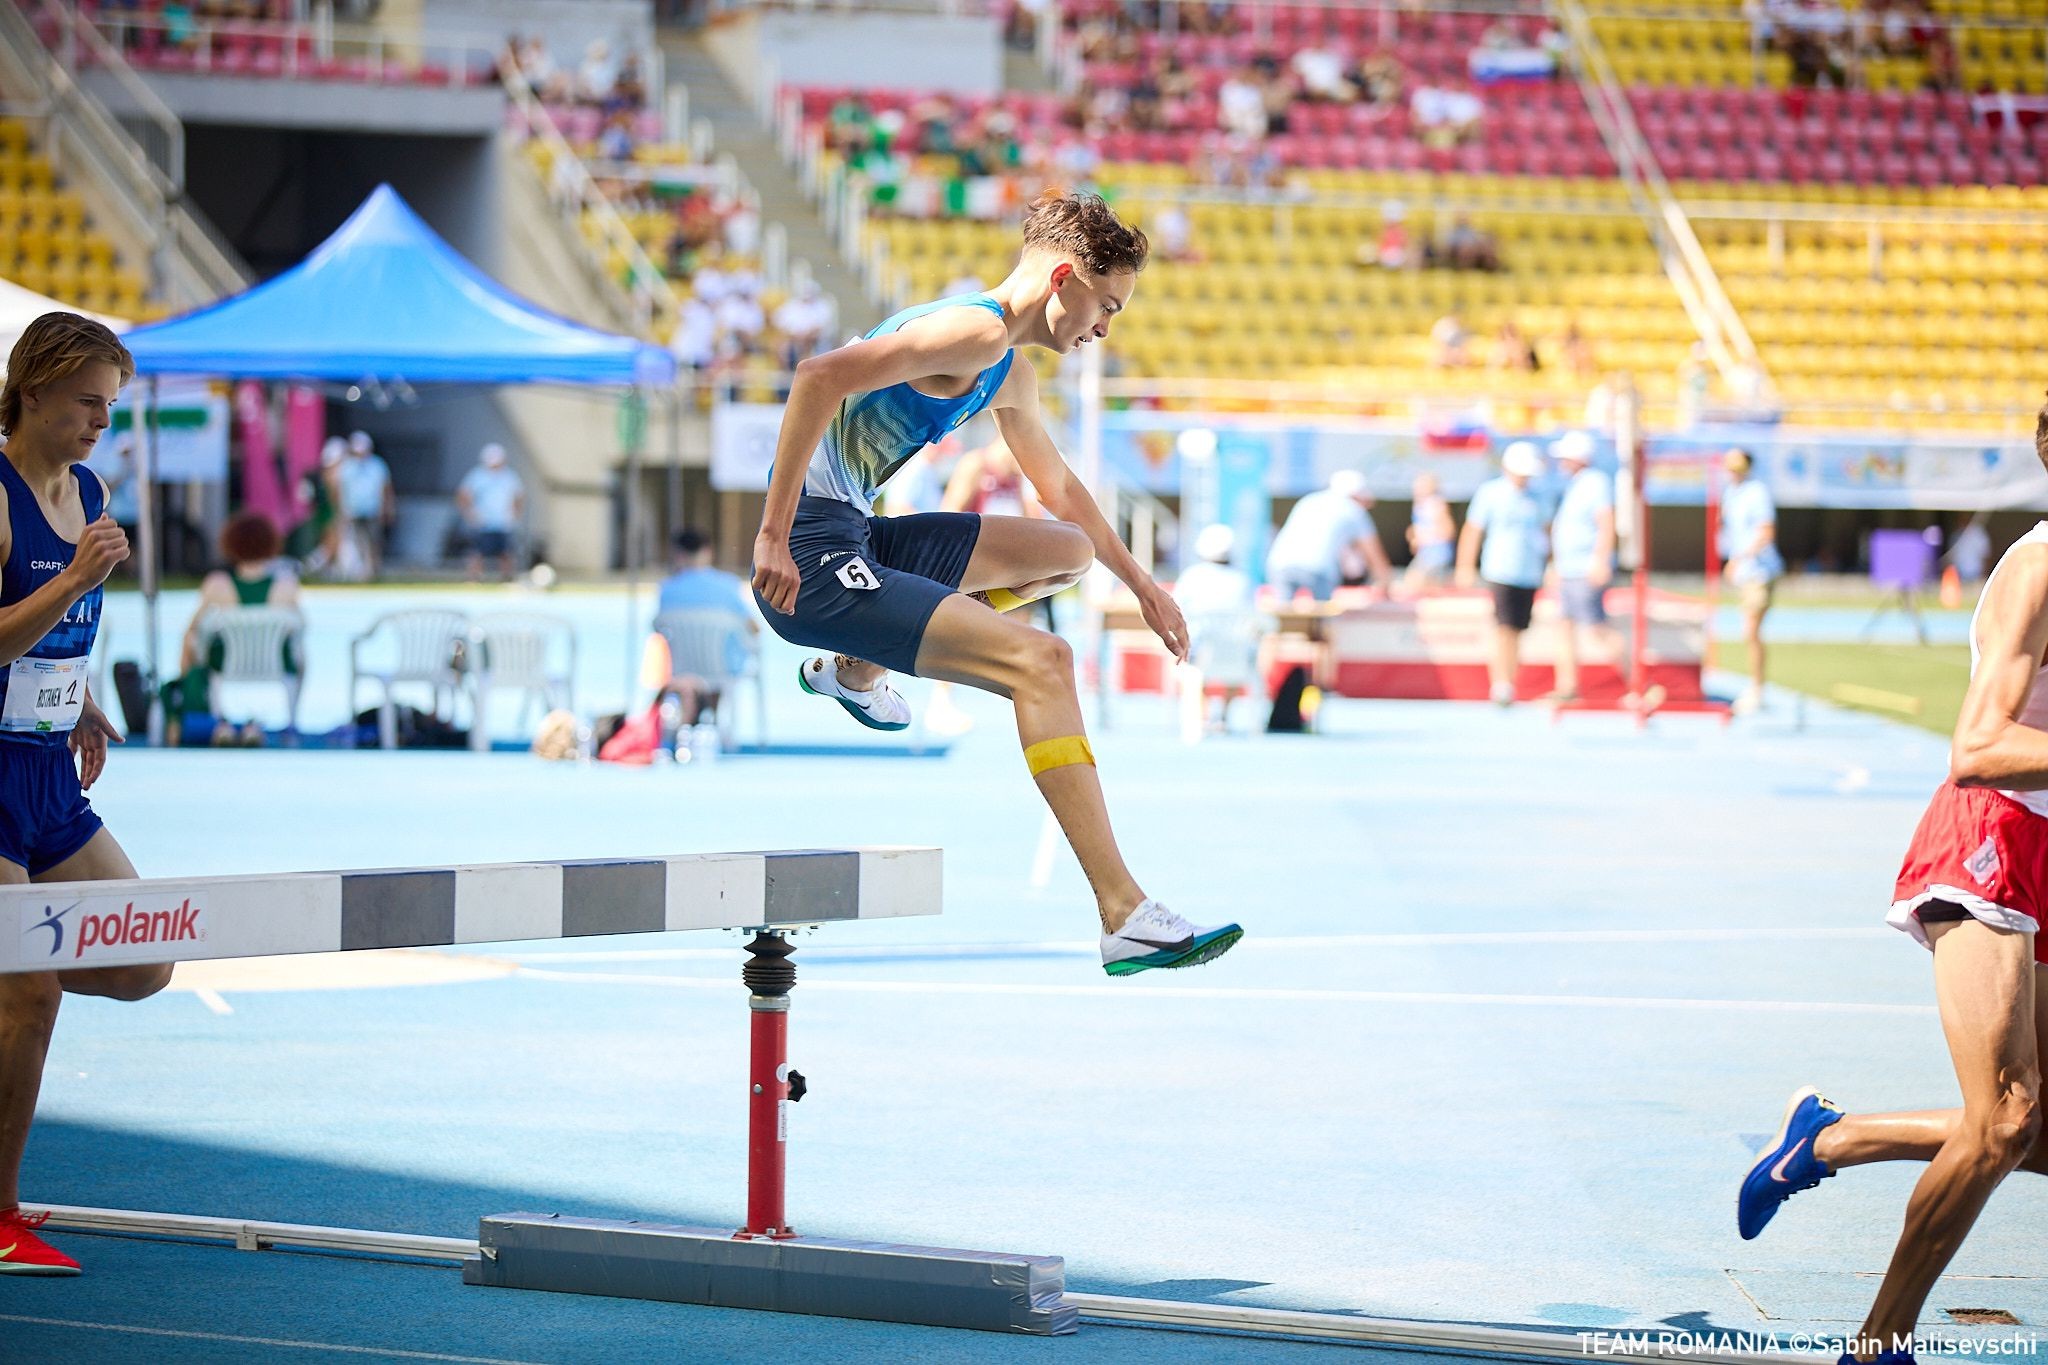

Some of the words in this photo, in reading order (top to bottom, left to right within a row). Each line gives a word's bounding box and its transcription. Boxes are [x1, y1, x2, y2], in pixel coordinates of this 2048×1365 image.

[31, 560, 61, 570] CRAFT
[65, 680, 77, 704] 1
[75, 897, 201, 959] polanik
